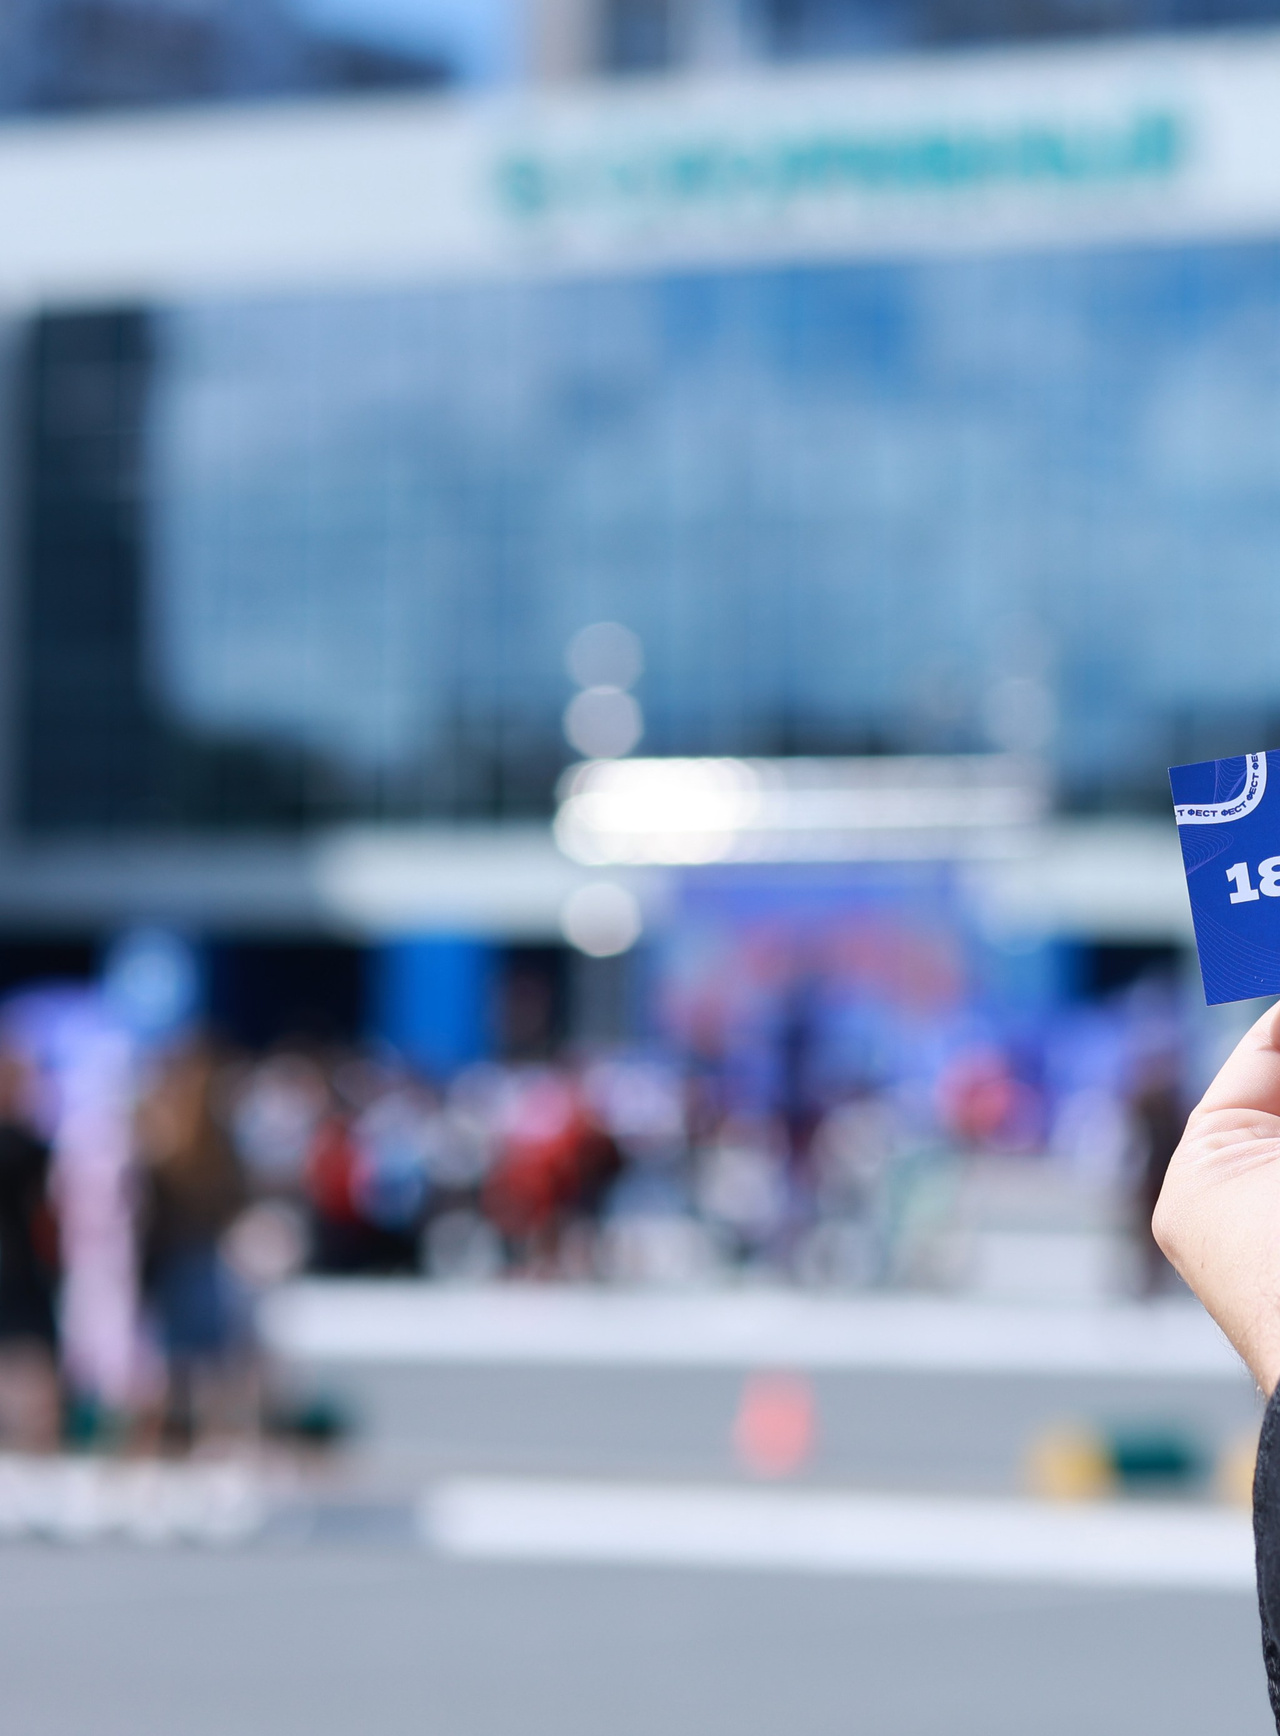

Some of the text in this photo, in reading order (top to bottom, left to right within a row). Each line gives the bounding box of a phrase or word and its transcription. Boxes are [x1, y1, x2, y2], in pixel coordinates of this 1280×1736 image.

[1251, 754, 1260, 770] ФЕ
[1246, 772, 1260, 801] ФЕСТ
[1187, 808, 1218, 817] ФЕСТ
[1220, 801, 1247, 816] ФЕСТ
